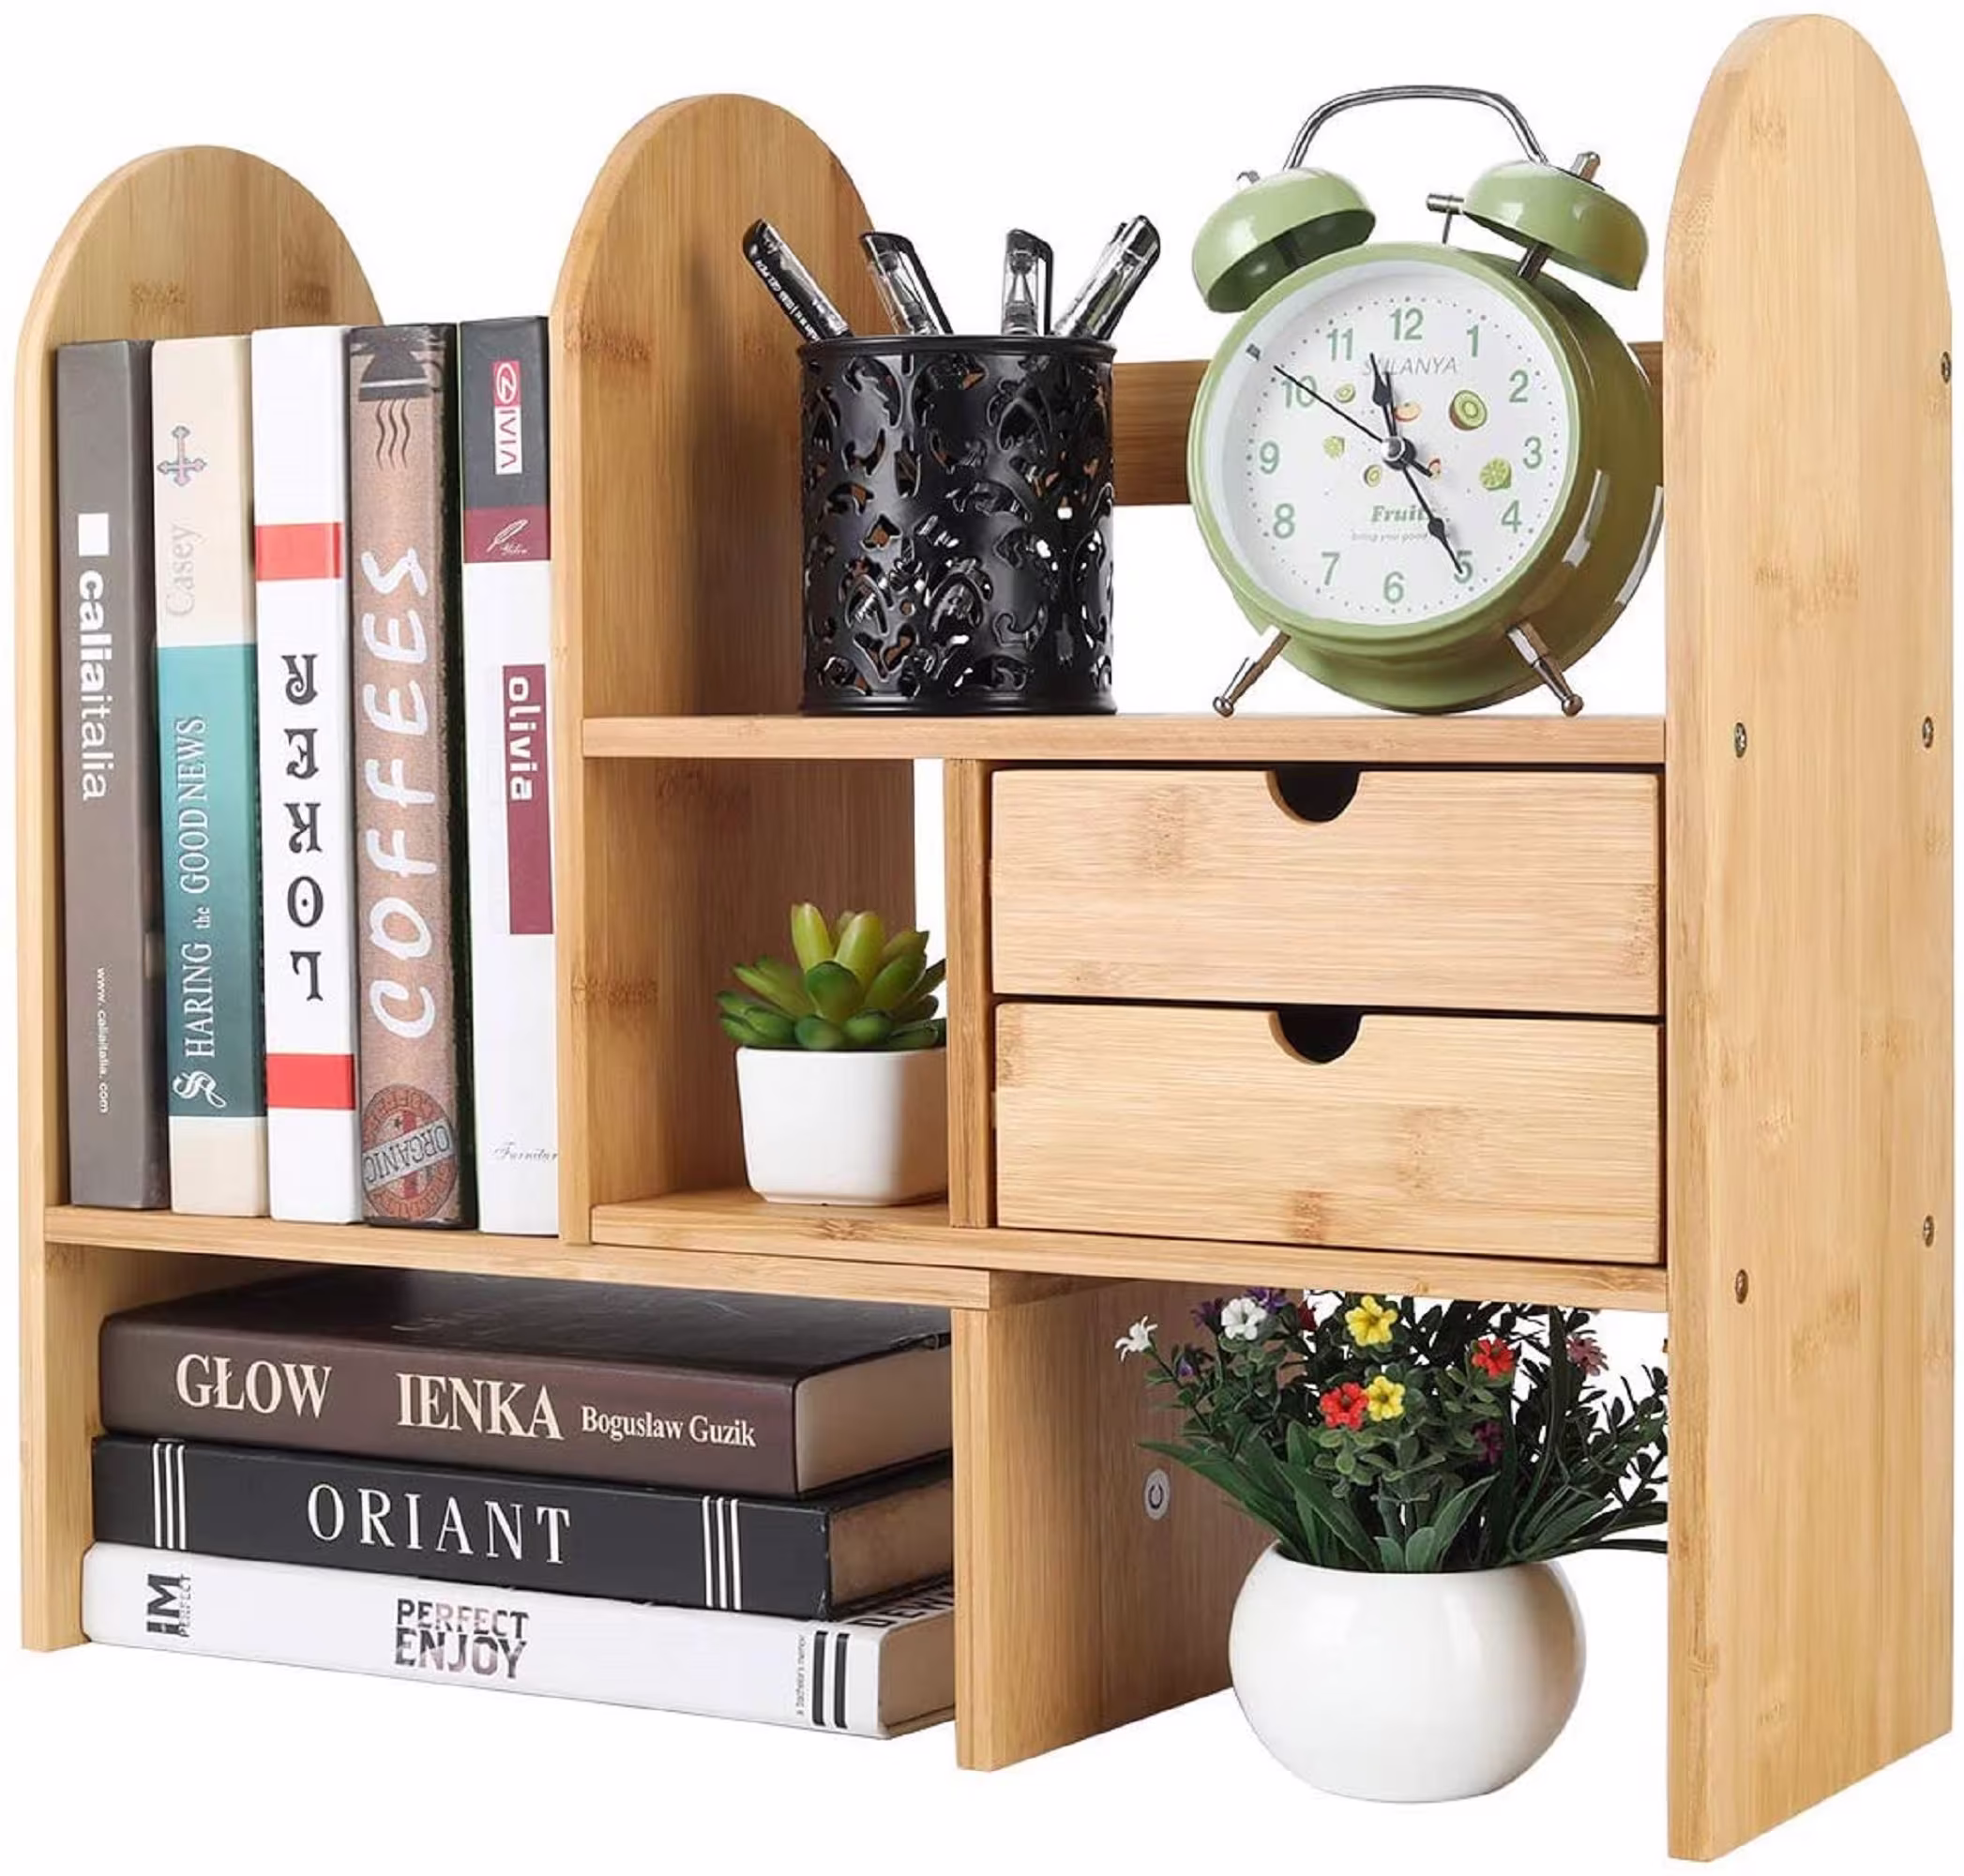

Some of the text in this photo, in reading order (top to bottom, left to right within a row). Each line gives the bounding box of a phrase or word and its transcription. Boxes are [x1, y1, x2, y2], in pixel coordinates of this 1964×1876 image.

[1390, 307, 1425, 341] 12
[1466, 325, 1480, 358] 1
[1326, 328, 1354, 361] 11
[1281, 375, 1318, 409] 10
[1509, 369, 1530, 404] 2
[1259, 441, 1280, 476] 9
[1522, 436, 1544, 469] 3
[1273, 503, 1295, 538] 8
[1501, 500, 1522, 534] 4
[165, 522, 200, 618] Casey
[1321, 551, 1340, 585] 7
[1453, 551, 1473, 584] 5
[1383, 571, 1404, 603] 6
[78, 569, 114, 801] caliaitalia
[509, 675, 541, 801] olivia
[174, 716, 208, 802] NEWS
[360, 548, 438, 1038] COFFEES
[282, 655, 325, 1002] LOKER
[177, 809, 210, 895] GOOD
[191, 905, 212, 930] the
[363, 1125, 450, 1184] ORGANIC
[174, 1353, 333, 1419] GŁOW
[395, 1372, 565, 1442] IENKA
[688, 1415, 757, 1448] Guzik
[306, 1482, 570, 1565] ORIANT
[397, 1596, 530, 1640] PERFECT
[394, 1626, 527, 1679] ENJOY
